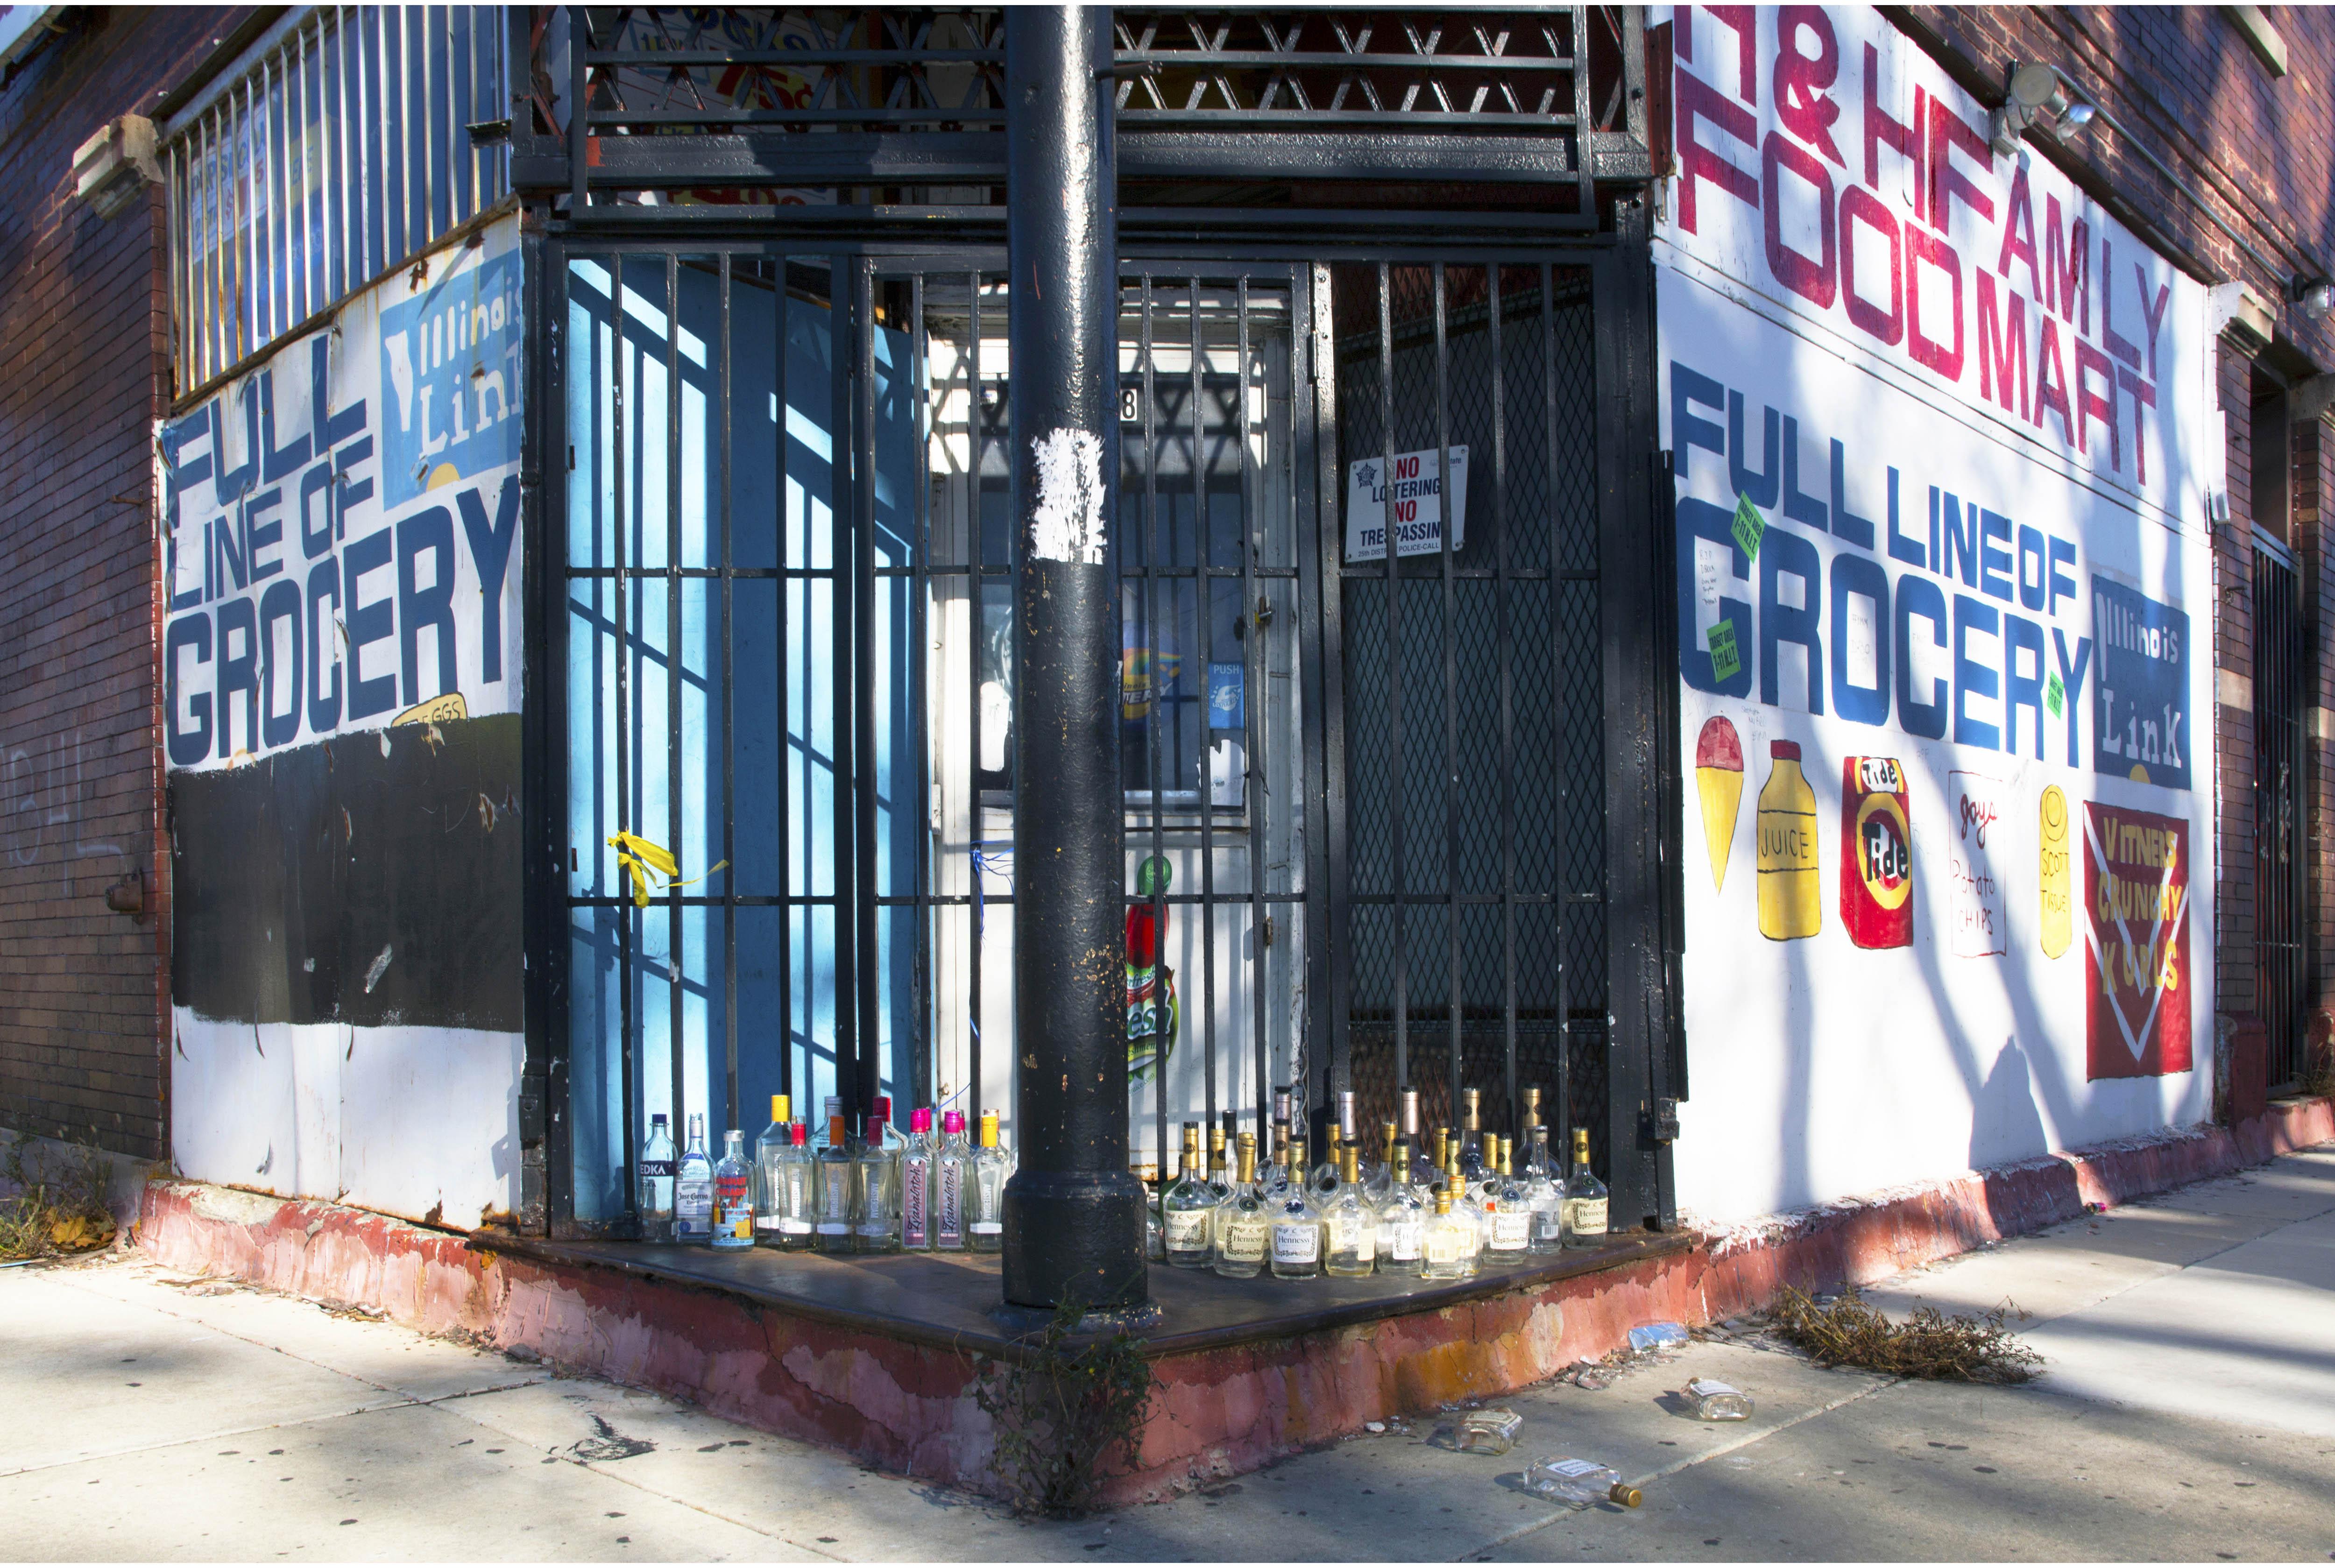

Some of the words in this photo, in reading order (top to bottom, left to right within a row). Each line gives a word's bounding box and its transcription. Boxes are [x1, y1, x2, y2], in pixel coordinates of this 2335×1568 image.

[1773, 5, 1847, 170] &
[1863, 40, 1925, 222] H
[1675, 63, 1963, 383] FOOD
[1976, 265, 2157, 487] MART
[1122, 390, 1135, 419] 8
[161, 334, 367, 530] FULL
[1396, 456, 1420, 480] NO
[1372, 477, 1440, 503] LOTERING
[1670, 359, 1875, 551] FULL
[1887, 465, 2013, 603] LINE
[2018, 524, 2076, 616] OF
[167, 487, 283, 612] LINE
[301, 434, 373, 560] OF
[1395, 500, 1417, 523] NO
[1734, 513, 1747, 538] 7-11
[1739, 498, 1754, 524] TARGET
[1751, 517, 1762, 538] AREA
[1399, 542, 1439, 552] POLICE-CALL
[167, 473, 521, 766] GROCERY
[1677, 496, 2092, 769] GROCERY
[2107, 597, 2179, 664] Illinois
[1709, 632, 1724, 650] TARGET
[1724, 627, 1735, 643] AREA
[1214, 664, 1239, 674] PUSH
[1713, 651, 1726, 673] 7-11
[2102, 688, 2181, 769] Link
[1862, 759, 1898, 785] Tide
[1761, 829, 1809, 859] JUICE
[1861, 822, 1908, 882] Tide
[2042, 848, 2069, 876] SCOTT
[1953, 860, 1995, 898] Potato
[2040, 890, 2066, 914] TISSUE
[2098, 870, 2182, 923] CRUNCHY
[1958, 910, 1993, 935] CHIPS
[2101, 938, 2178, 995] KURLS
[690, 1192, 708, 1201] Cuervo
[715, 1187, 747, 1196] CHICAGO
[1168, 1222, 1199, 1231] Hennessy
